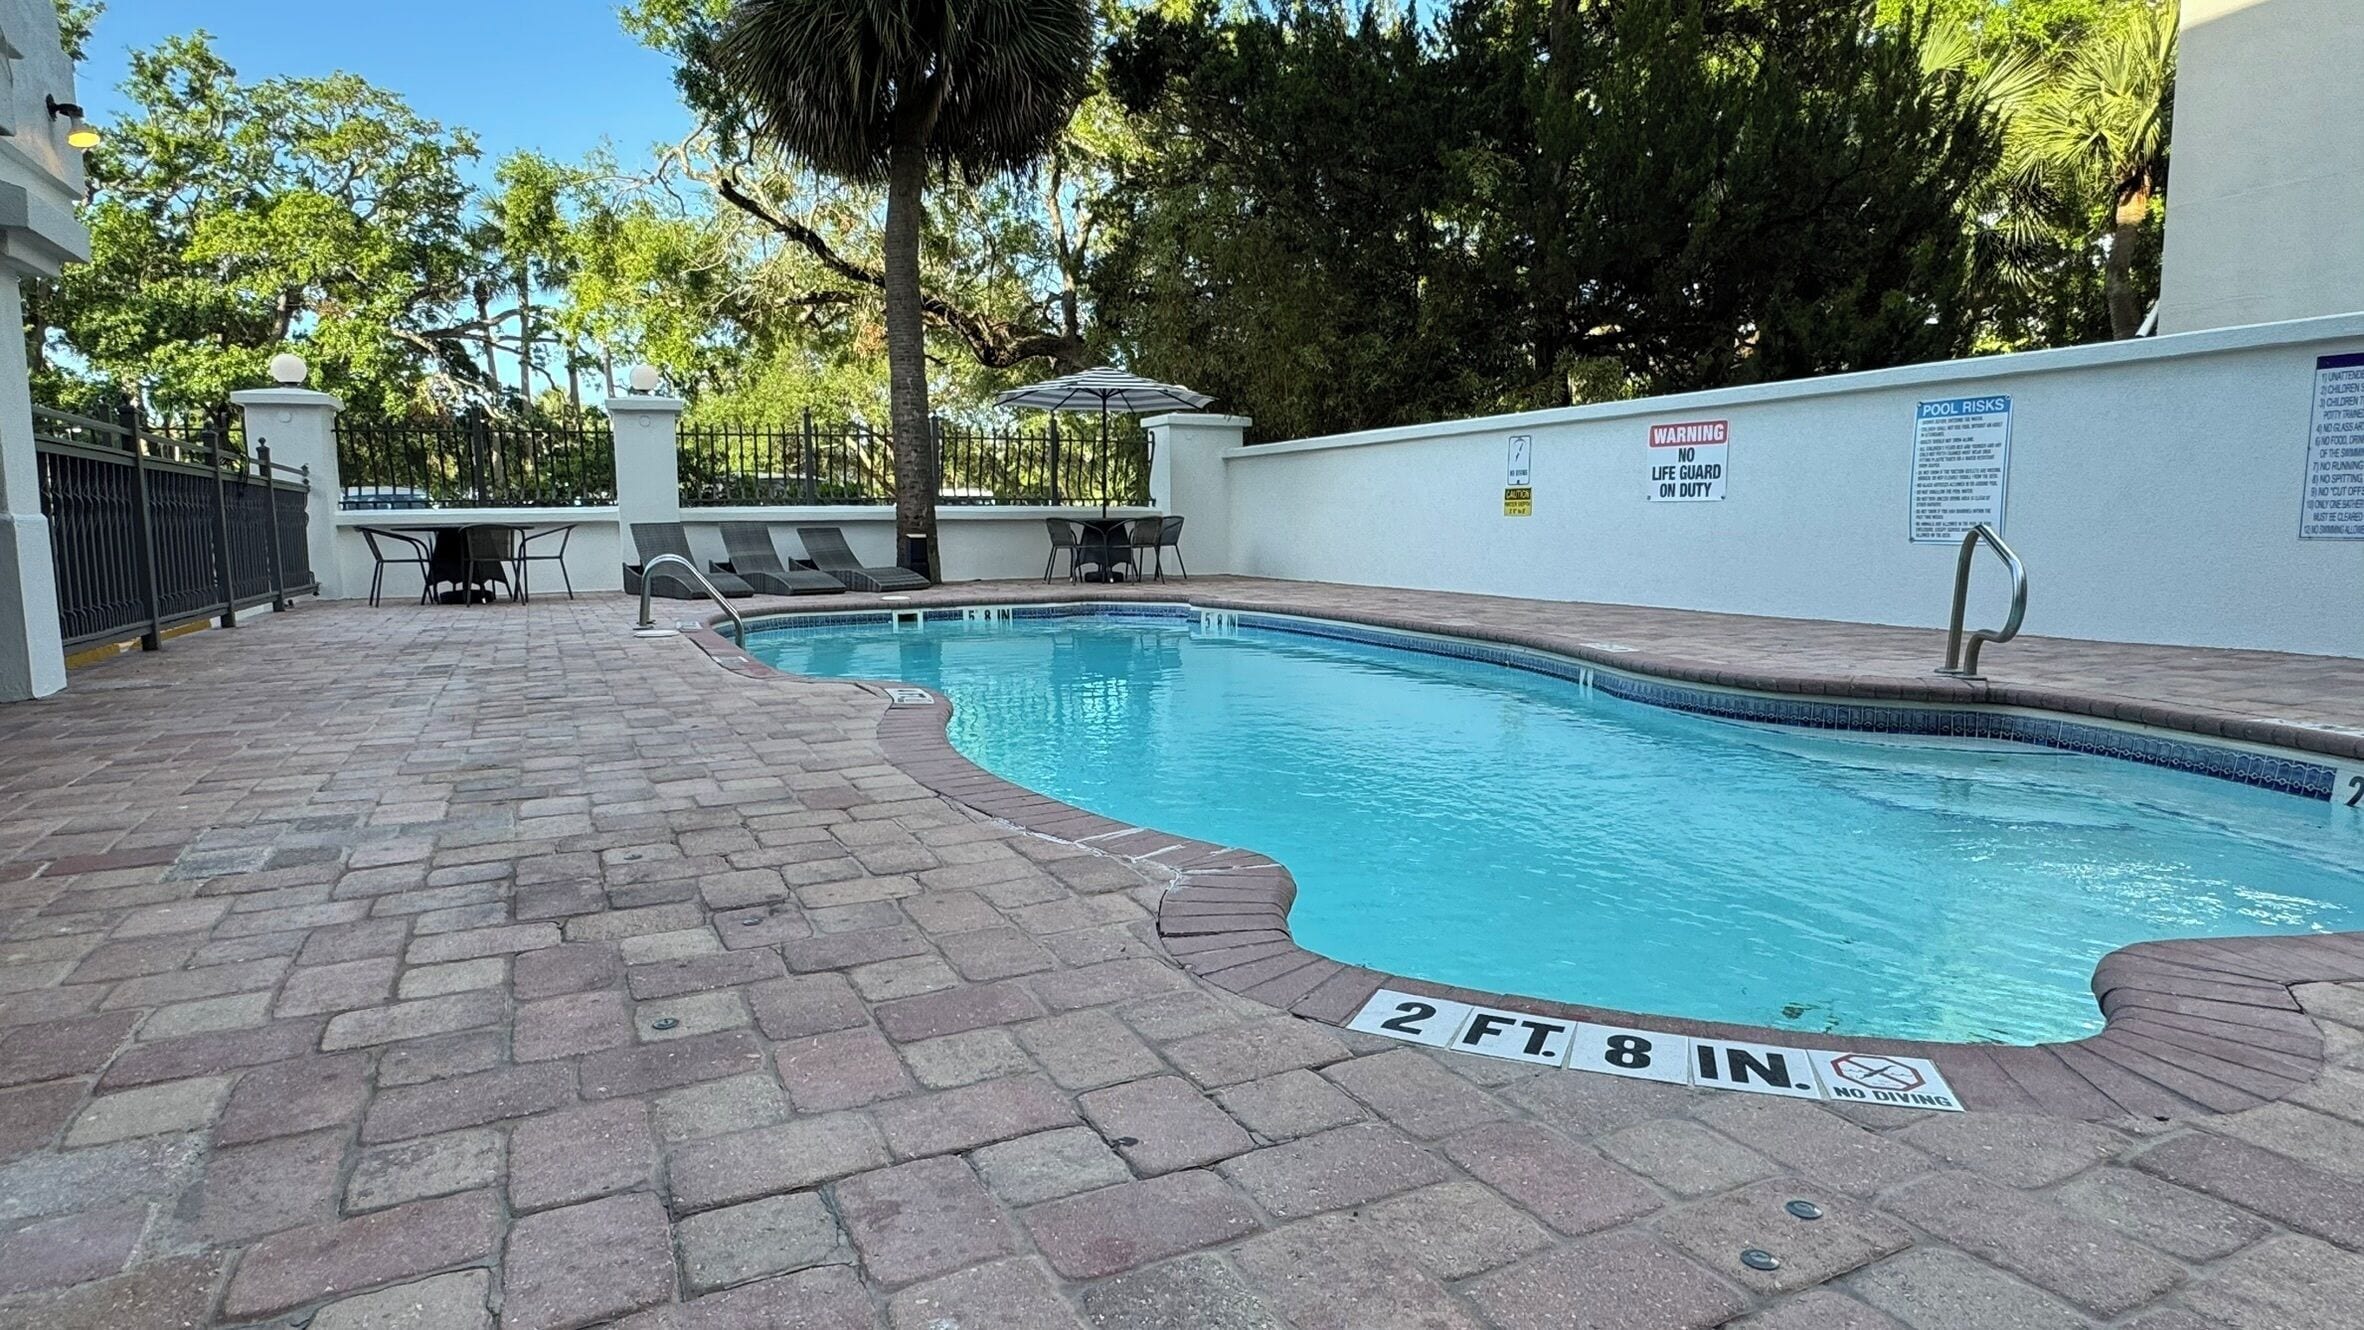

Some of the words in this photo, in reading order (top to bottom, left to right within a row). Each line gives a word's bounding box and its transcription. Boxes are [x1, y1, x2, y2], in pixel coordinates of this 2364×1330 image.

[2328, 383, 2360, 394] CHILDREN
[1922, 402, 1958, 416] POOL
[1962, 398, 2005, 413] RISKS
[2327, 396, 2359, 407] CHILDREN
[2323, 423, 2332, 433] NO
[2333, 422, 2354, 432] GLASS
[1653, 423, 1724, 445] WARNING
[2321, 436, 2330, 446] NO
[1678, 447, 1695, 463] NO
[2320, 461, 2330, 471] NO
[1652, 465, 1676, 481] LIFE
[1680, 464, 1721, 480] GUARD
[2320, 474, 2330, 484] NO
[1506, 489, 1530, 499] CAUTION
[1659, 483, 1676, 498] ON
[1680, 482, 1712, 498] DUTY
[2319, 486, 2329, 497] NO
[997, 608, 1010, 620] IN
[1380, 1001, 1438, 1035] 2
[1462, 1013, 1566, 1058] FT.
[1604, 1034, 1651, 1069] 8
[1697, 1045, 1811, 1090] IN.
[1833, 1086, 1866, 1099] NO
[1872, 1090, 1953, 1107] DIVING
